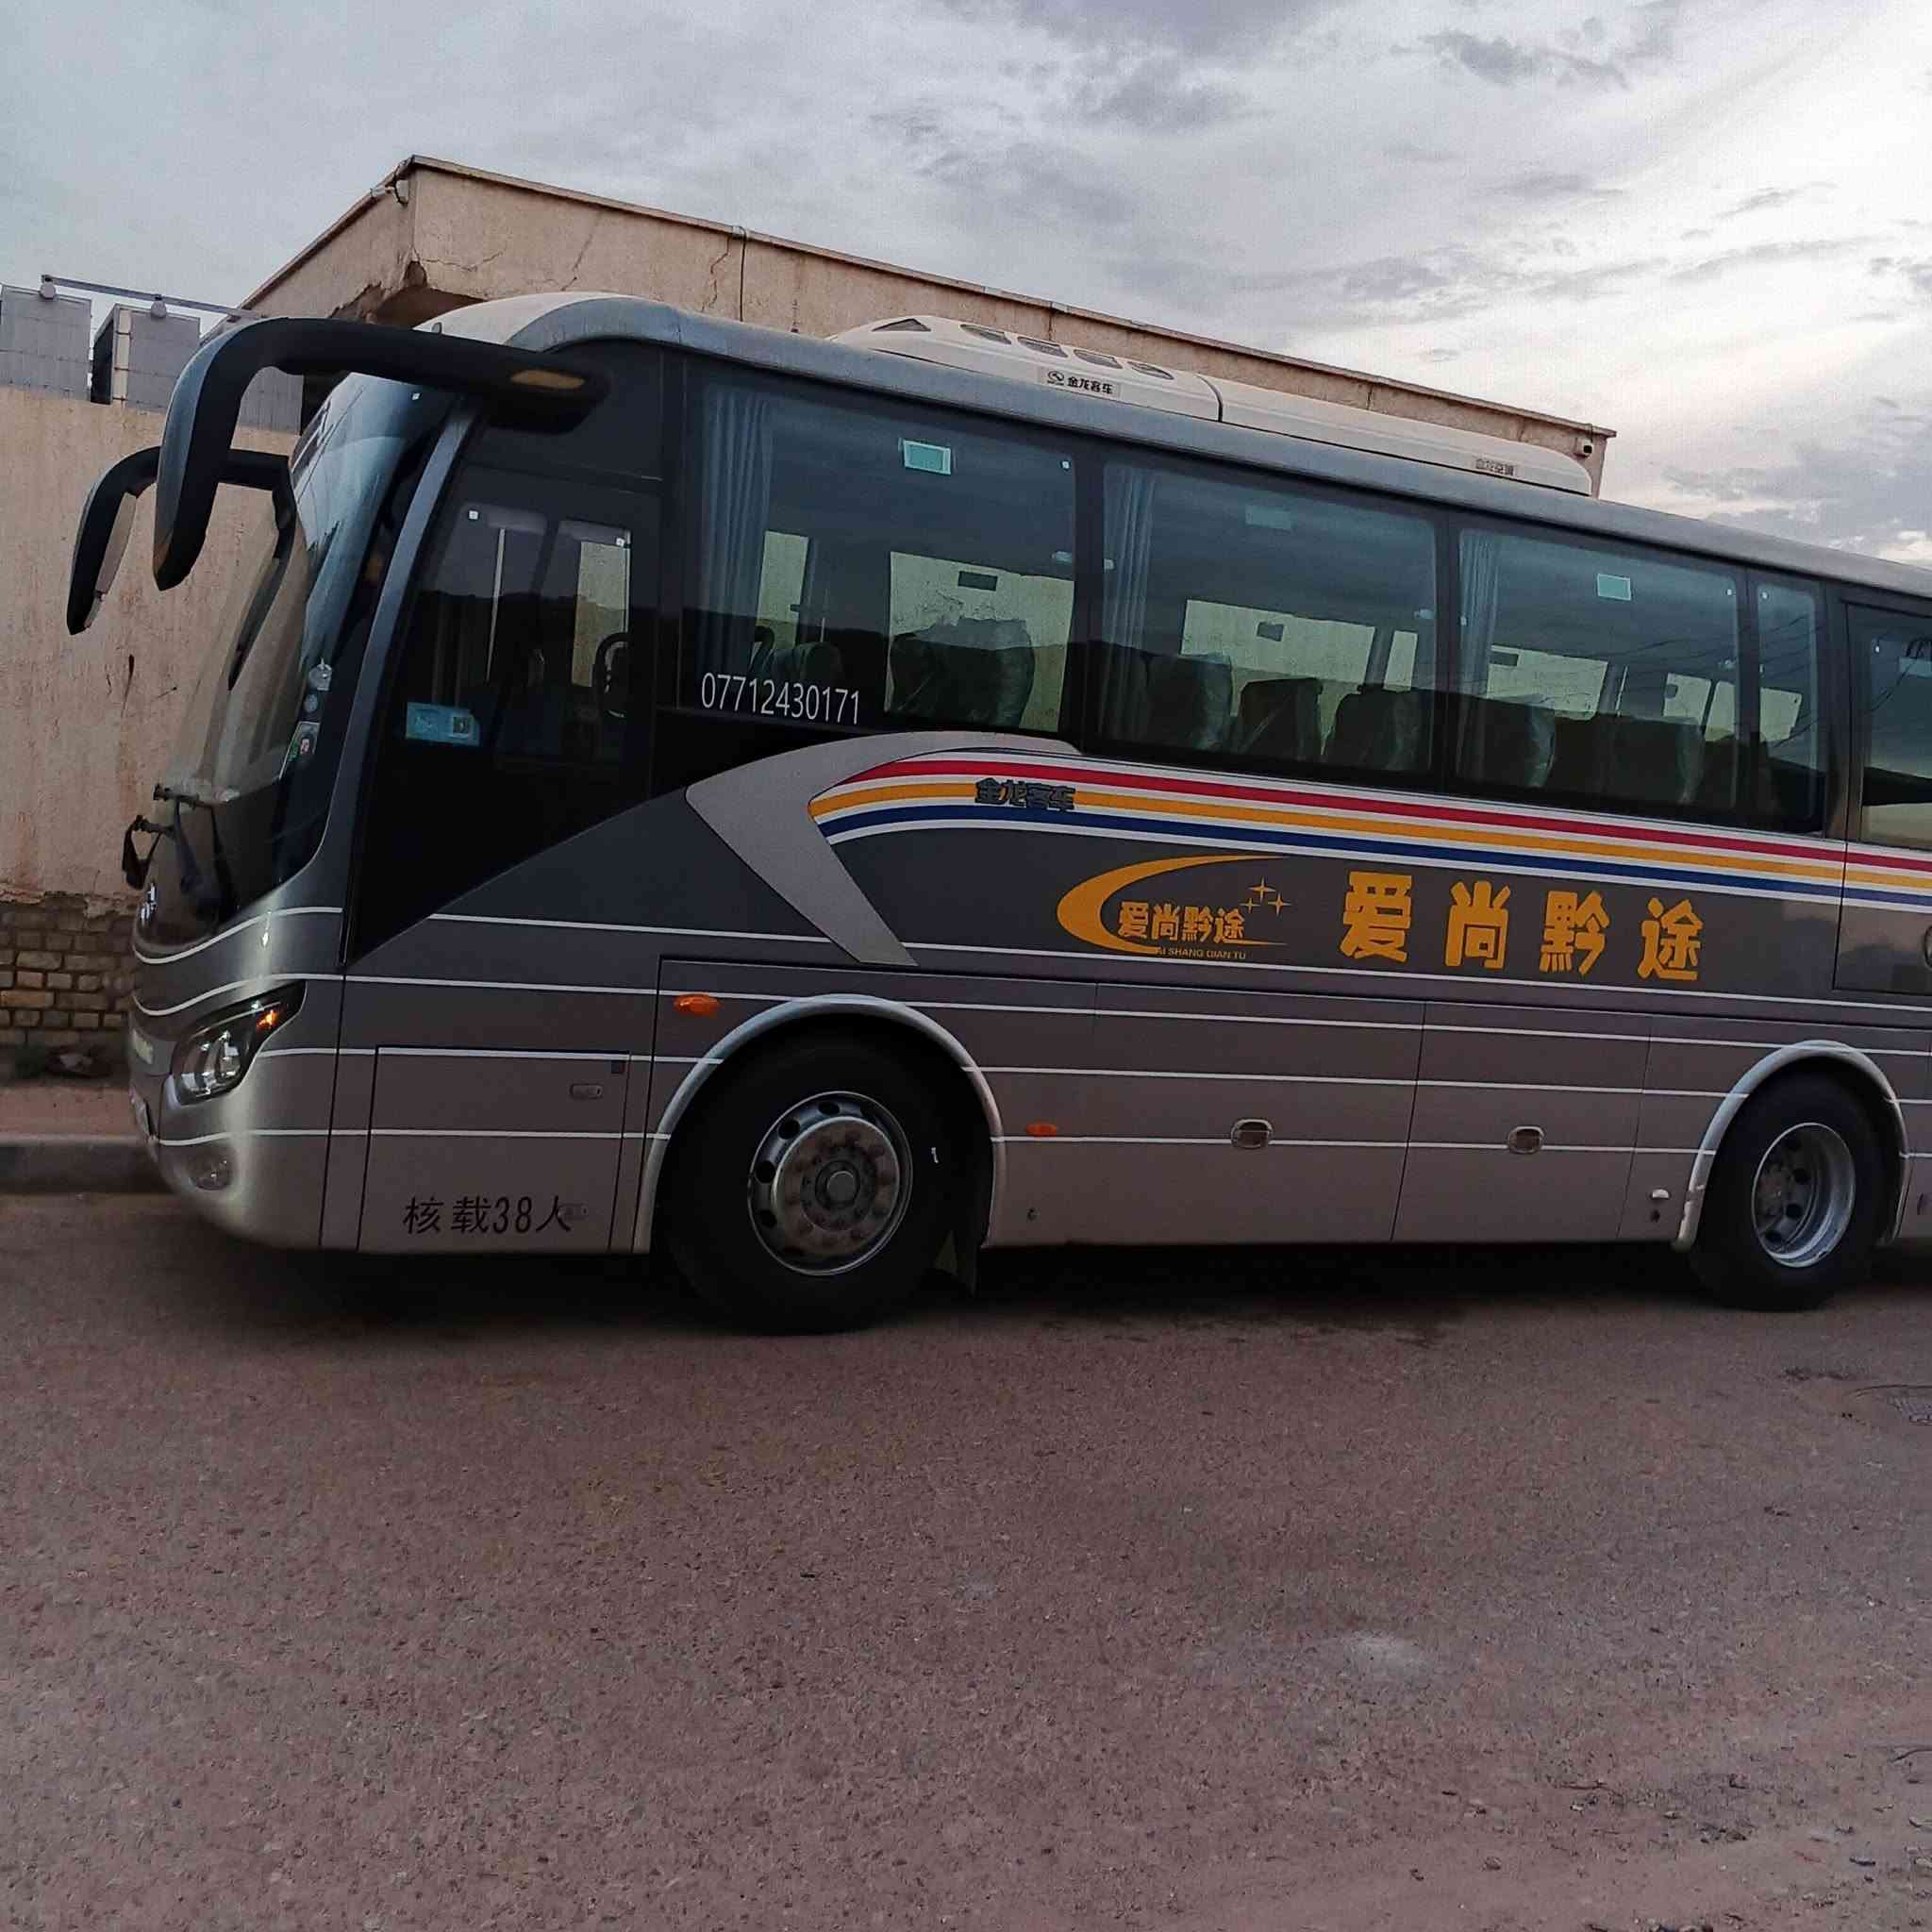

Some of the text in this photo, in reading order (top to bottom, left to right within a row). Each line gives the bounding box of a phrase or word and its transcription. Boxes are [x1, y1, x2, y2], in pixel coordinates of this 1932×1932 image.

[1066, 375, 1114, 394] 金龙客车
[701, 672, 859, 724] 07712430171
[974, 776, 1076, 812] 金龙客车
[1118, 900, 1245, 943] 爱尚黔途
[1340, 870, 1704, 981] 爱尚黔途
[402, 1194, 573, 1234] 核载38人
